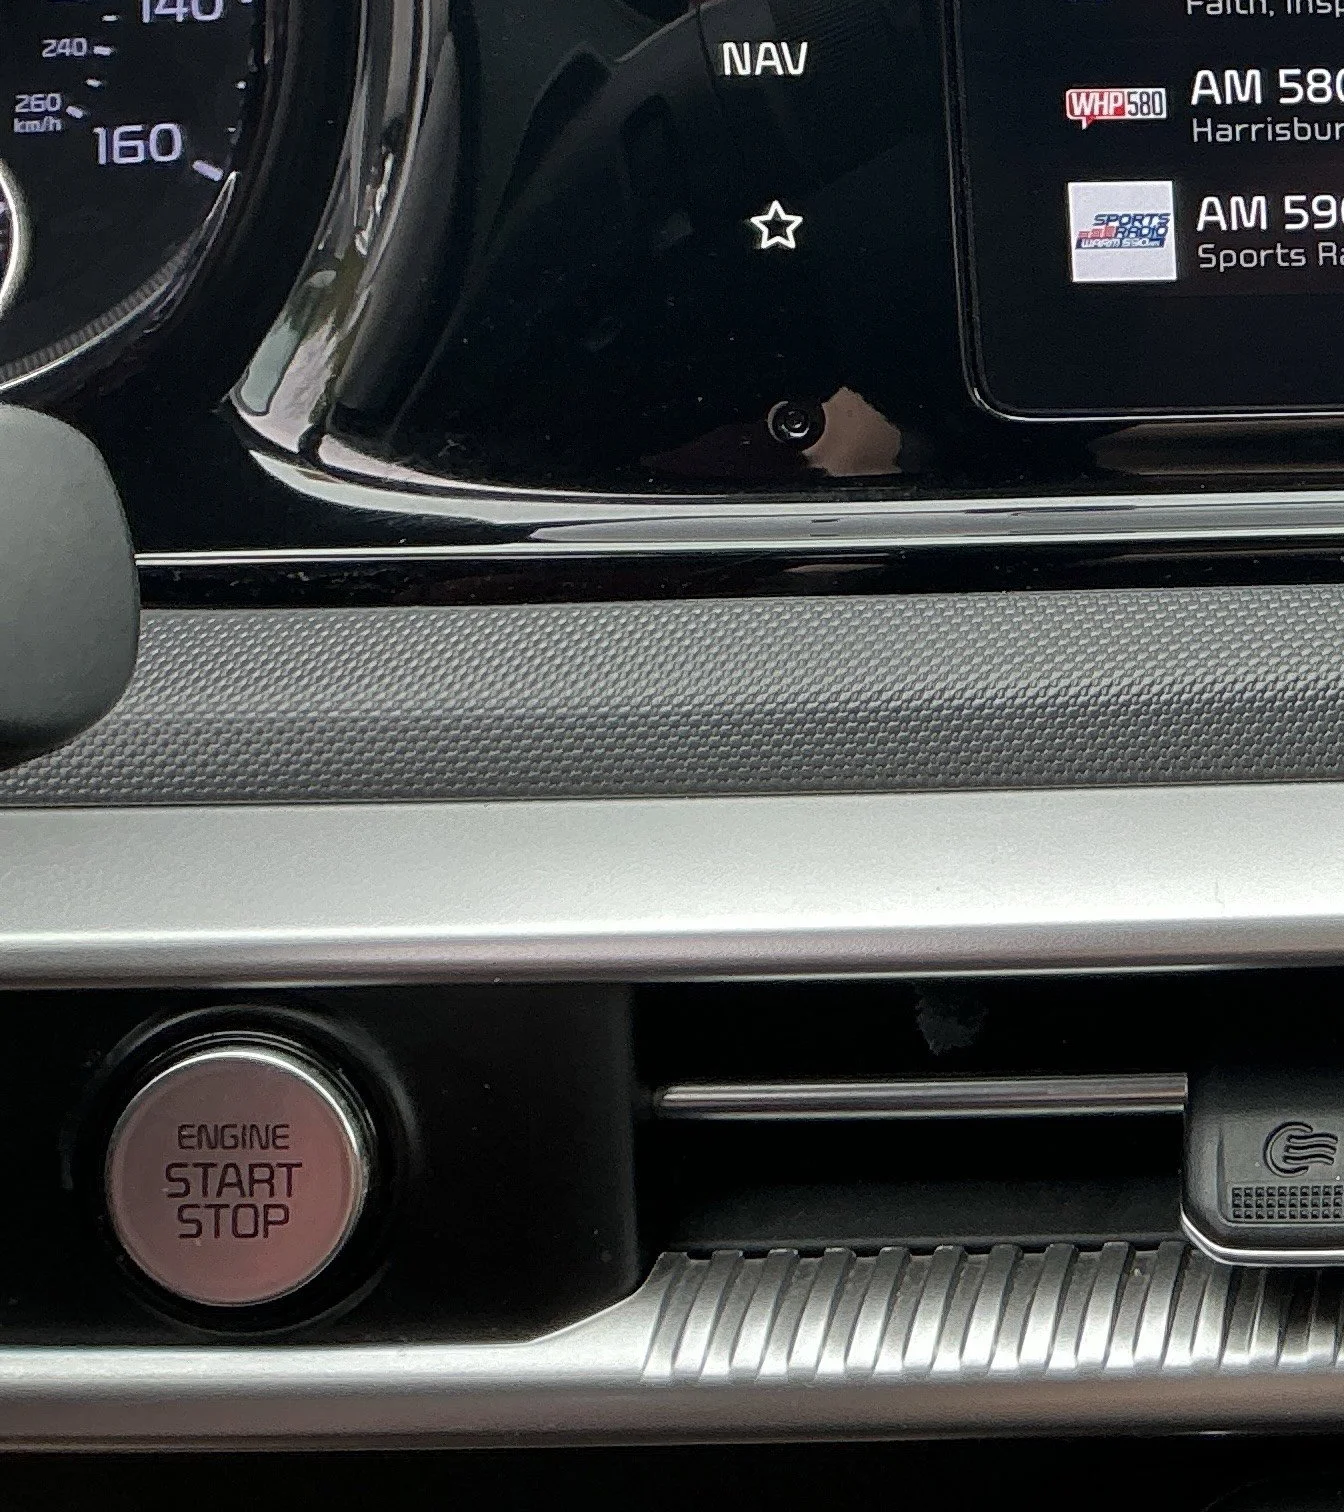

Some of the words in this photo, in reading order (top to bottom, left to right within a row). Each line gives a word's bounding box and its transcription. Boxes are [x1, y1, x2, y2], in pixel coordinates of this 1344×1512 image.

[42, 38, 88, 57] 240
[723, 42, 807, 75] NAV
[15, 93, 61, 113] 260
[1191, 69, 1261, 105] AM
[94, 123, 182, 164] 160
[1197, 196, 1267, 231] AM
[1198, 243, 1306, 272] Sports
[178, 1124, 290, 1150] ENGINE
[165, 1163, 302, 1198] START
[178, 1204, 290, 1239] STOP
